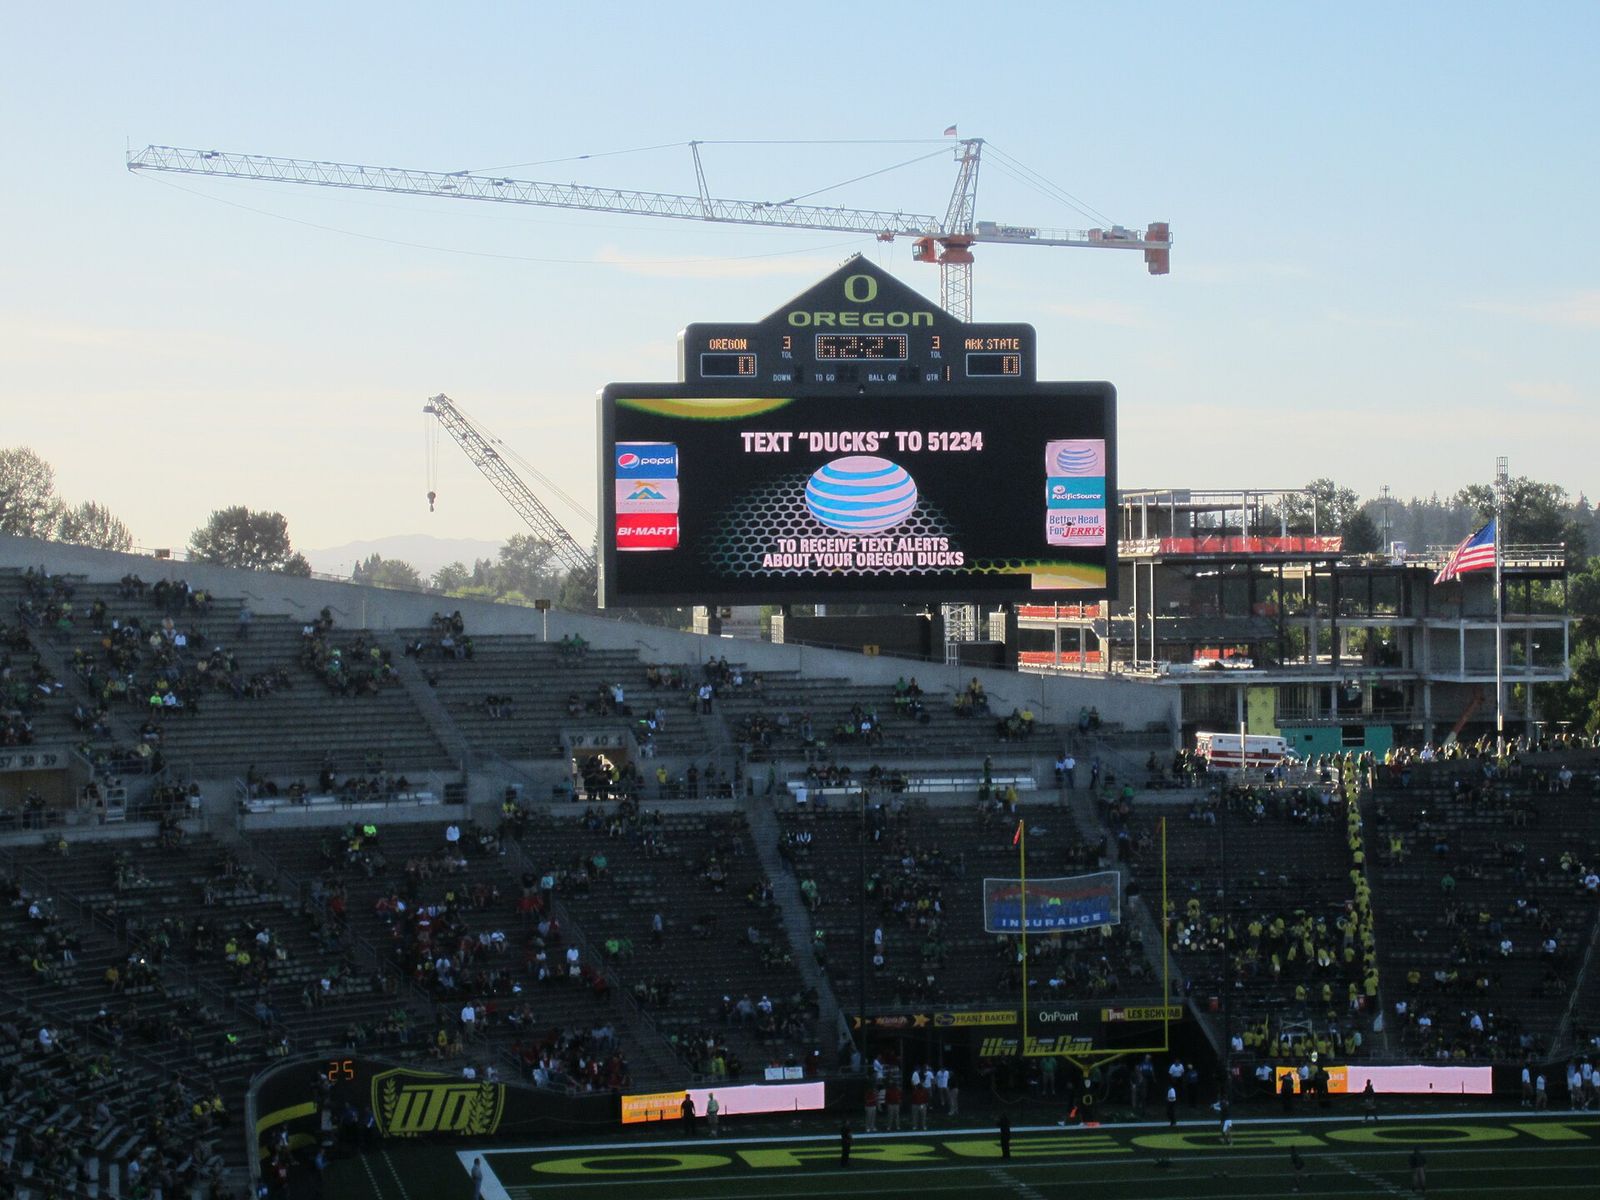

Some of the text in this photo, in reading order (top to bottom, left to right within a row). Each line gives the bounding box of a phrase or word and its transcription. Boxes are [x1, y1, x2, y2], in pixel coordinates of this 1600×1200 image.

[844, 274, 878, 303] O
[788, 311, 934, 327] OREGON
[709, 338, 747, 350] OREGON
[782, 336, 791, 350] 3
[818, 336, 906, 358] 62:27
[931, 335, 941, 349] 3
[964, 338, 1020, 350] ARK STATE
[781, 351, 792, 359] TOL
[930, 351, 941, 359] TOL
[738, 356, 754, 375] 0
[1003, 355, 1019, 374] 0
[773, 373, 792, 382] DOWN
[815, 373, 835, 382] TO GO
[868, 373, 897, 382] BALL ON
[926, 373, 939, 382] QTR
[740, 432, 793, 452] TEXT
[895, 431, 922, 451] TO
[928, 431, 983, 451] 51234
[640, 456, 674, 466] pepsi
[1049, 515, 1099, 525] Better Head
[1049, 526, 1065, 535] For
[777, 537, 949, 553] TO RECEIVE TEXT ALERTS
[762, 551, 964, 568] ABOUT YOUR OREGON DUCKS
[1039, 1011, 1080, 1023] OnPoint
[1127, 1009, 1143, 1019] LES
[327, 1060, 354, 1082] 25
